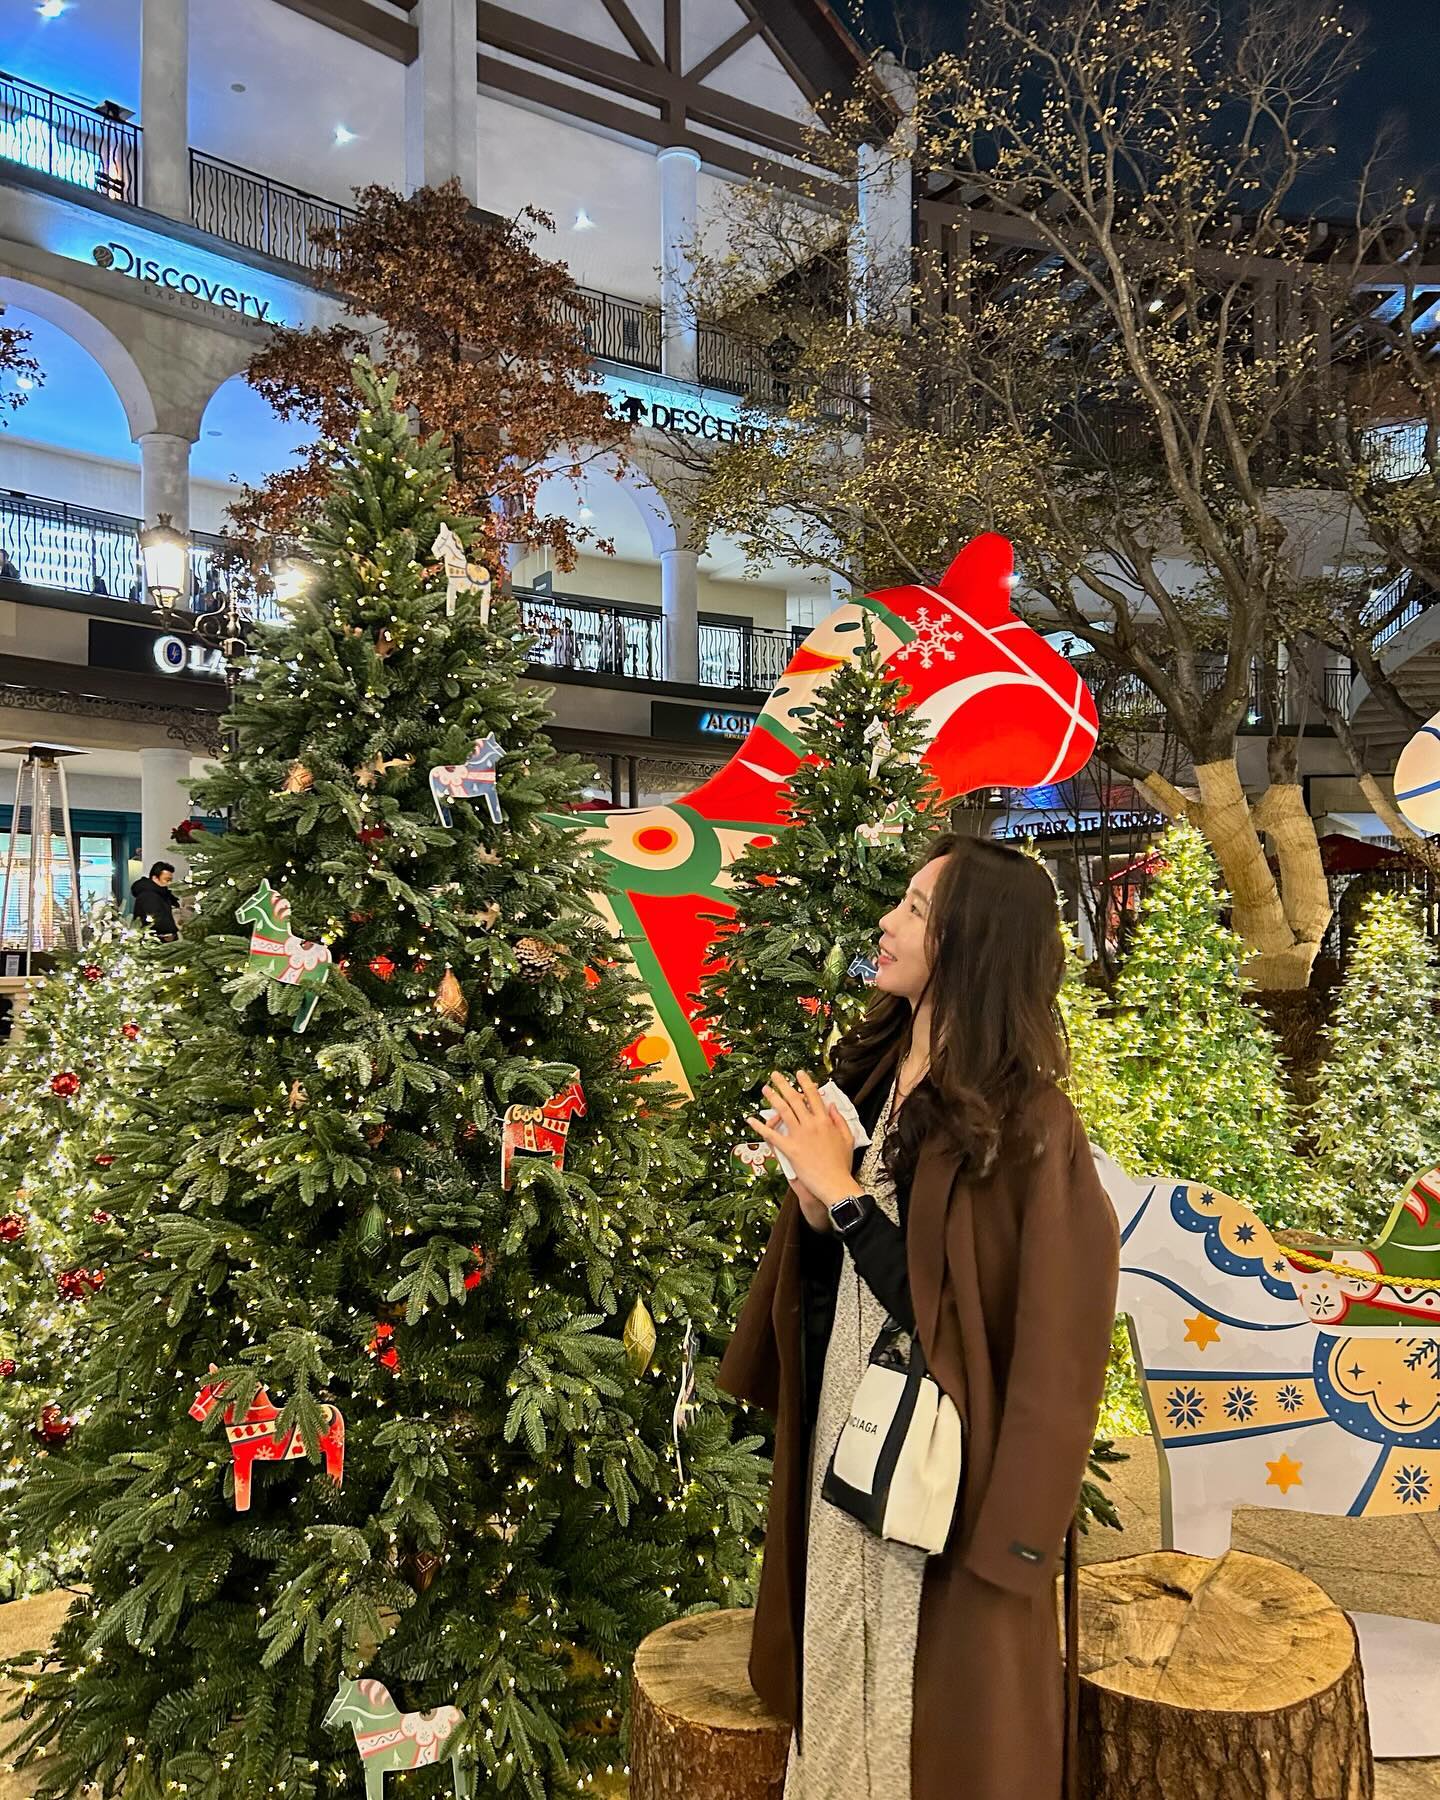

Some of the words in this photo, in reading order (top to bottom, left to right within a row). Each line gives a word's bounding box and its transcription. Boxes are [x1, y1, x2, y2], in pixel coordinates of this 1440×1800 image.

[94, 242, 270, 319] Discovery
[143, 284, 250, 327] EXPEDITION
[652, 403, 767, 446] DESCENT
[706, 713, 751, 732] ALOH
[1012, 819, 1070, 838] OUTBACK
